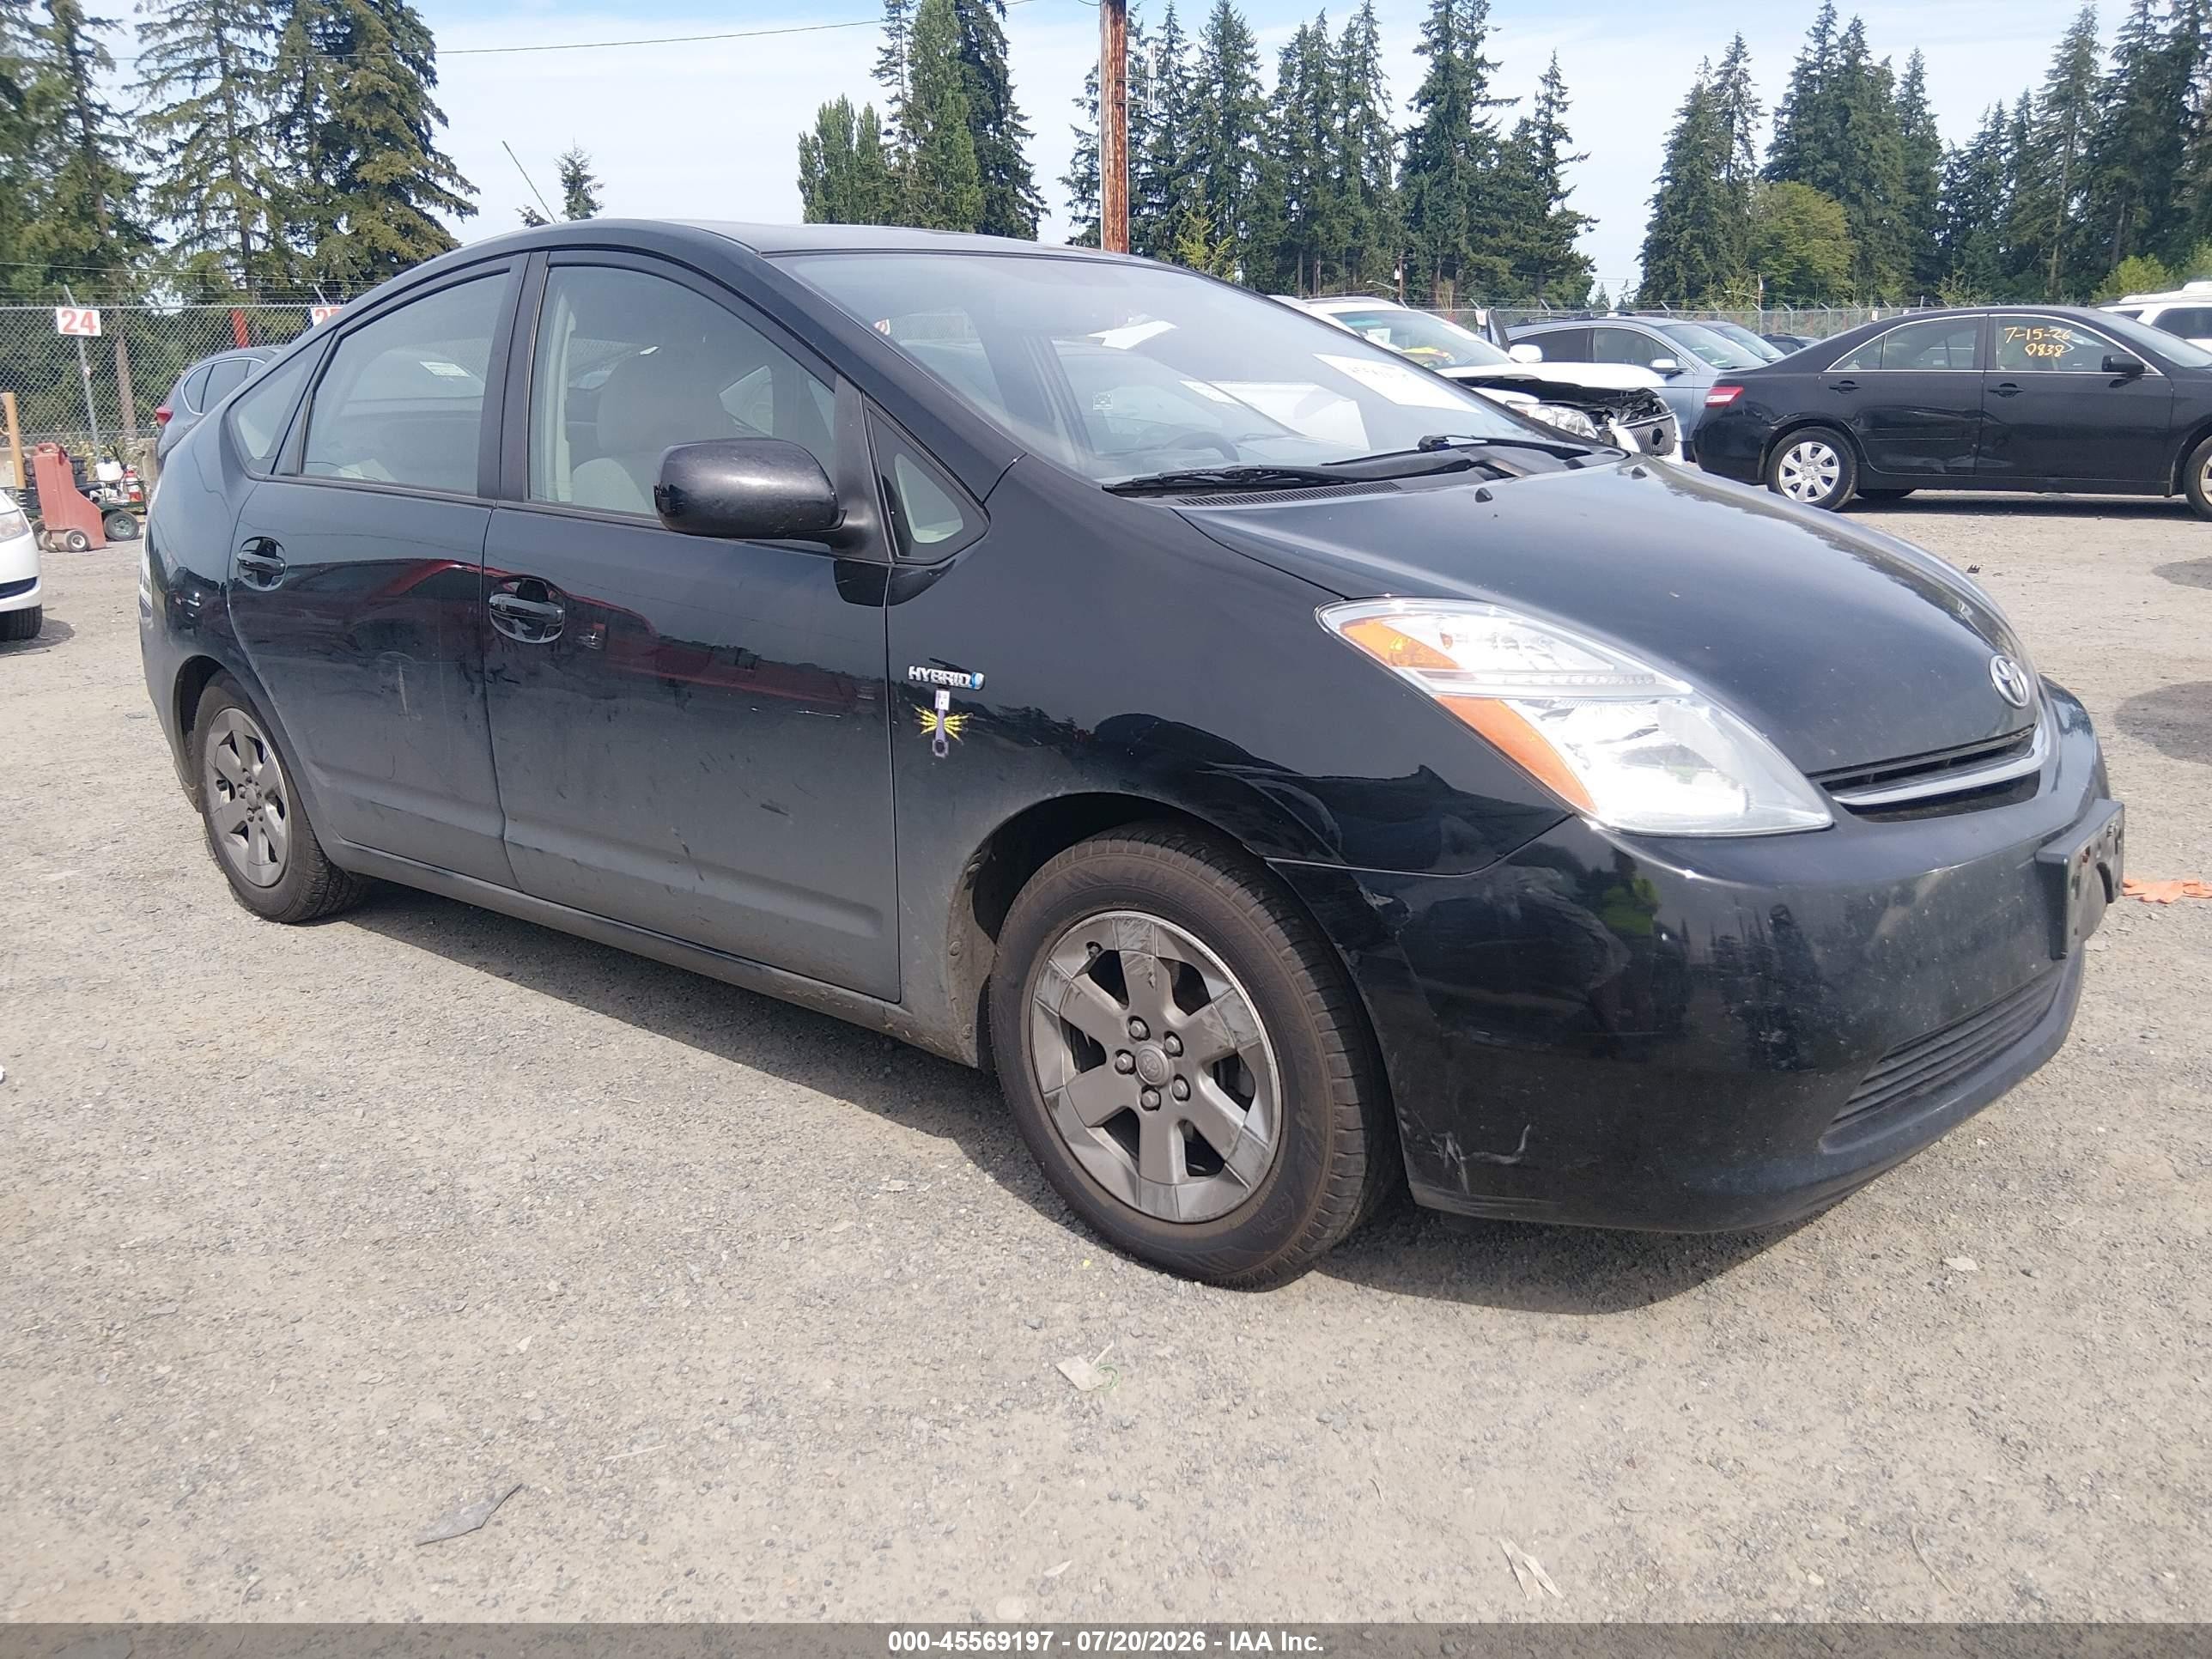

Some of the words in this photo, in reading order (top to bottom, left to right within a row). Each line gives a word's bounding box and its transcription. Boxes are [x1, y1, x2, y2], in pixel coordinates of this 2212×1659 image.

[61, 309, 96, 334] 24
[2003, 326, 2073, 343] 7-15-26
[2024, 343, 2065, 357] 0838
[908, 665, 972, 687] HYBRID
